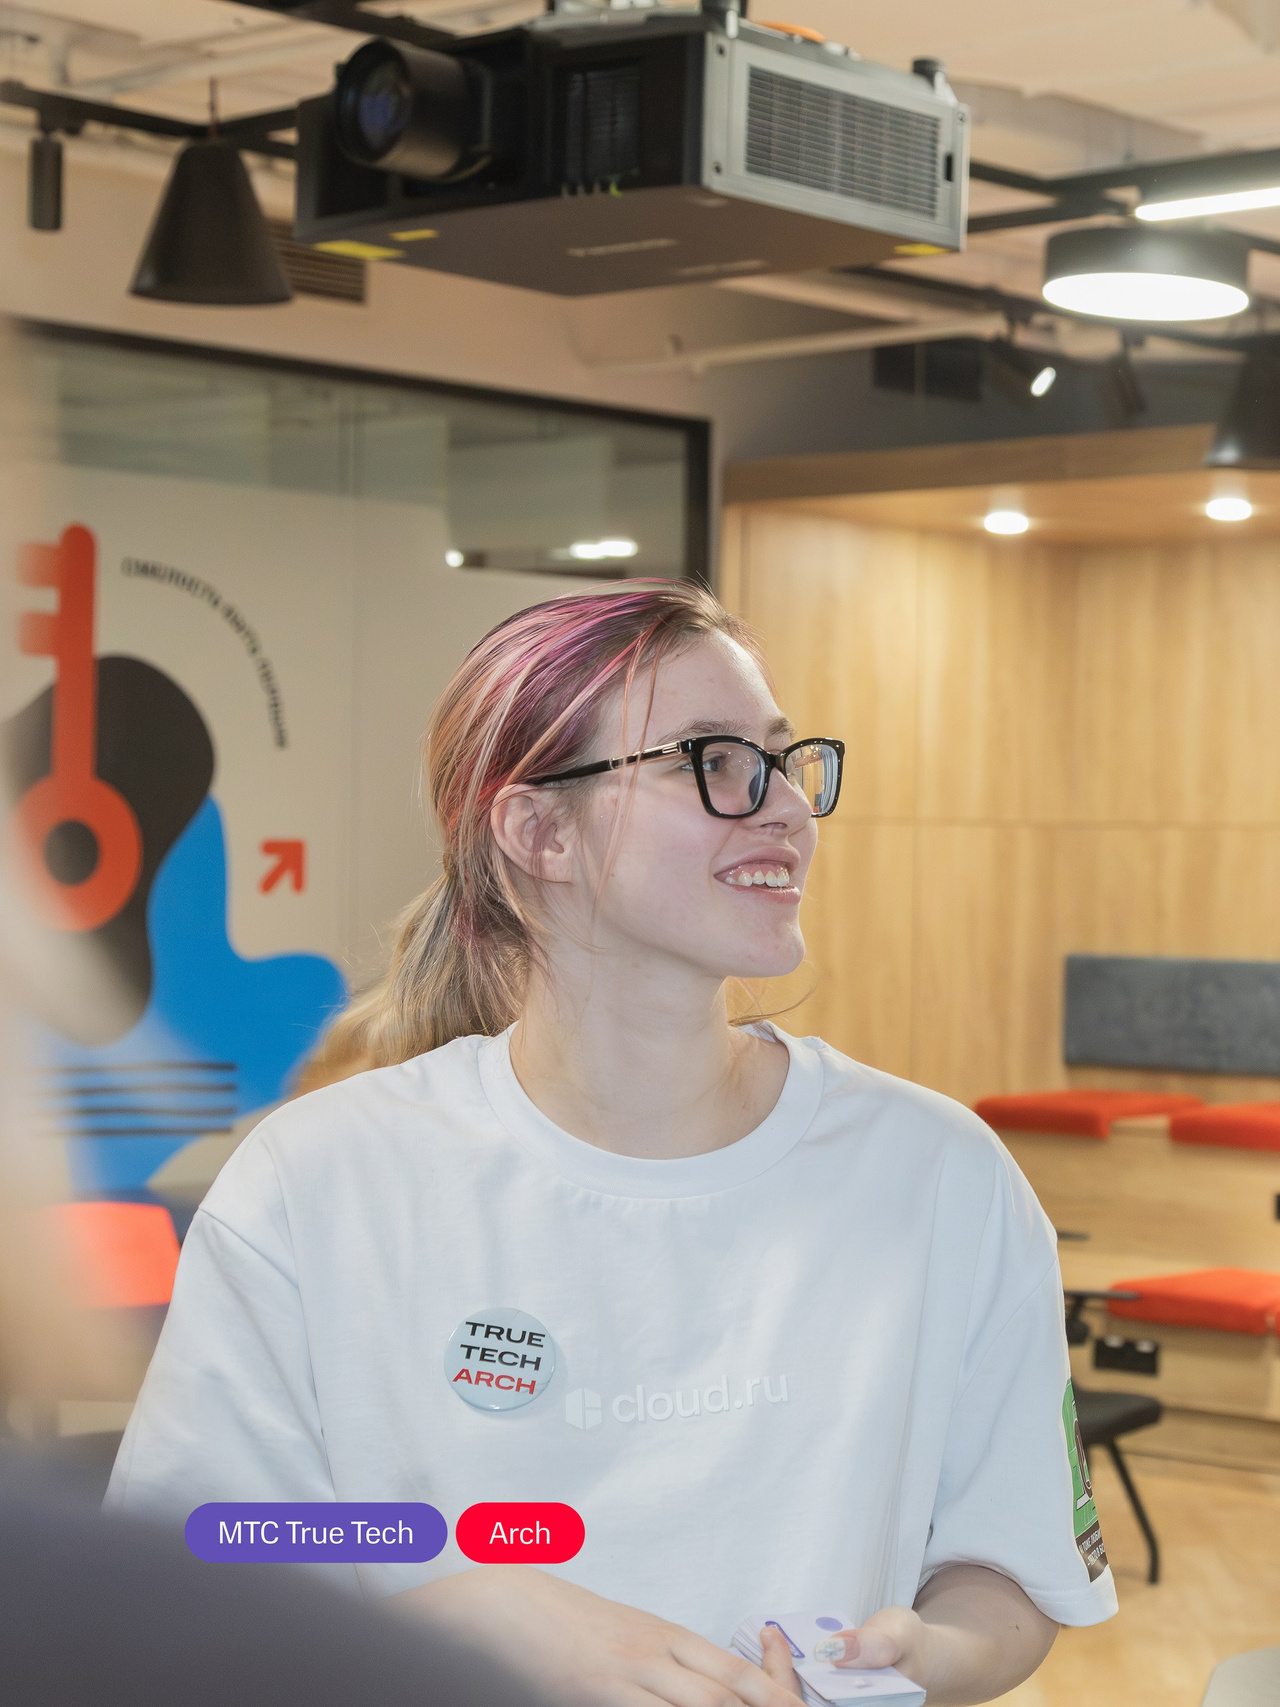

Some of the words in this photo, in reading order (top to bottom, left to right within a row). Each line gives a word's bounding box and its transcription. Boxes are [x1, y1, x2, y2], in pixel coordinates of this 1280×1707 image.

[465, 1321, 546, 1348] TRUE
[460, 1344, 542, 1372] TECH
[452, 1368, 537, 1395] ARCH
[612, 1374, 789, 1423] cloud.ru
